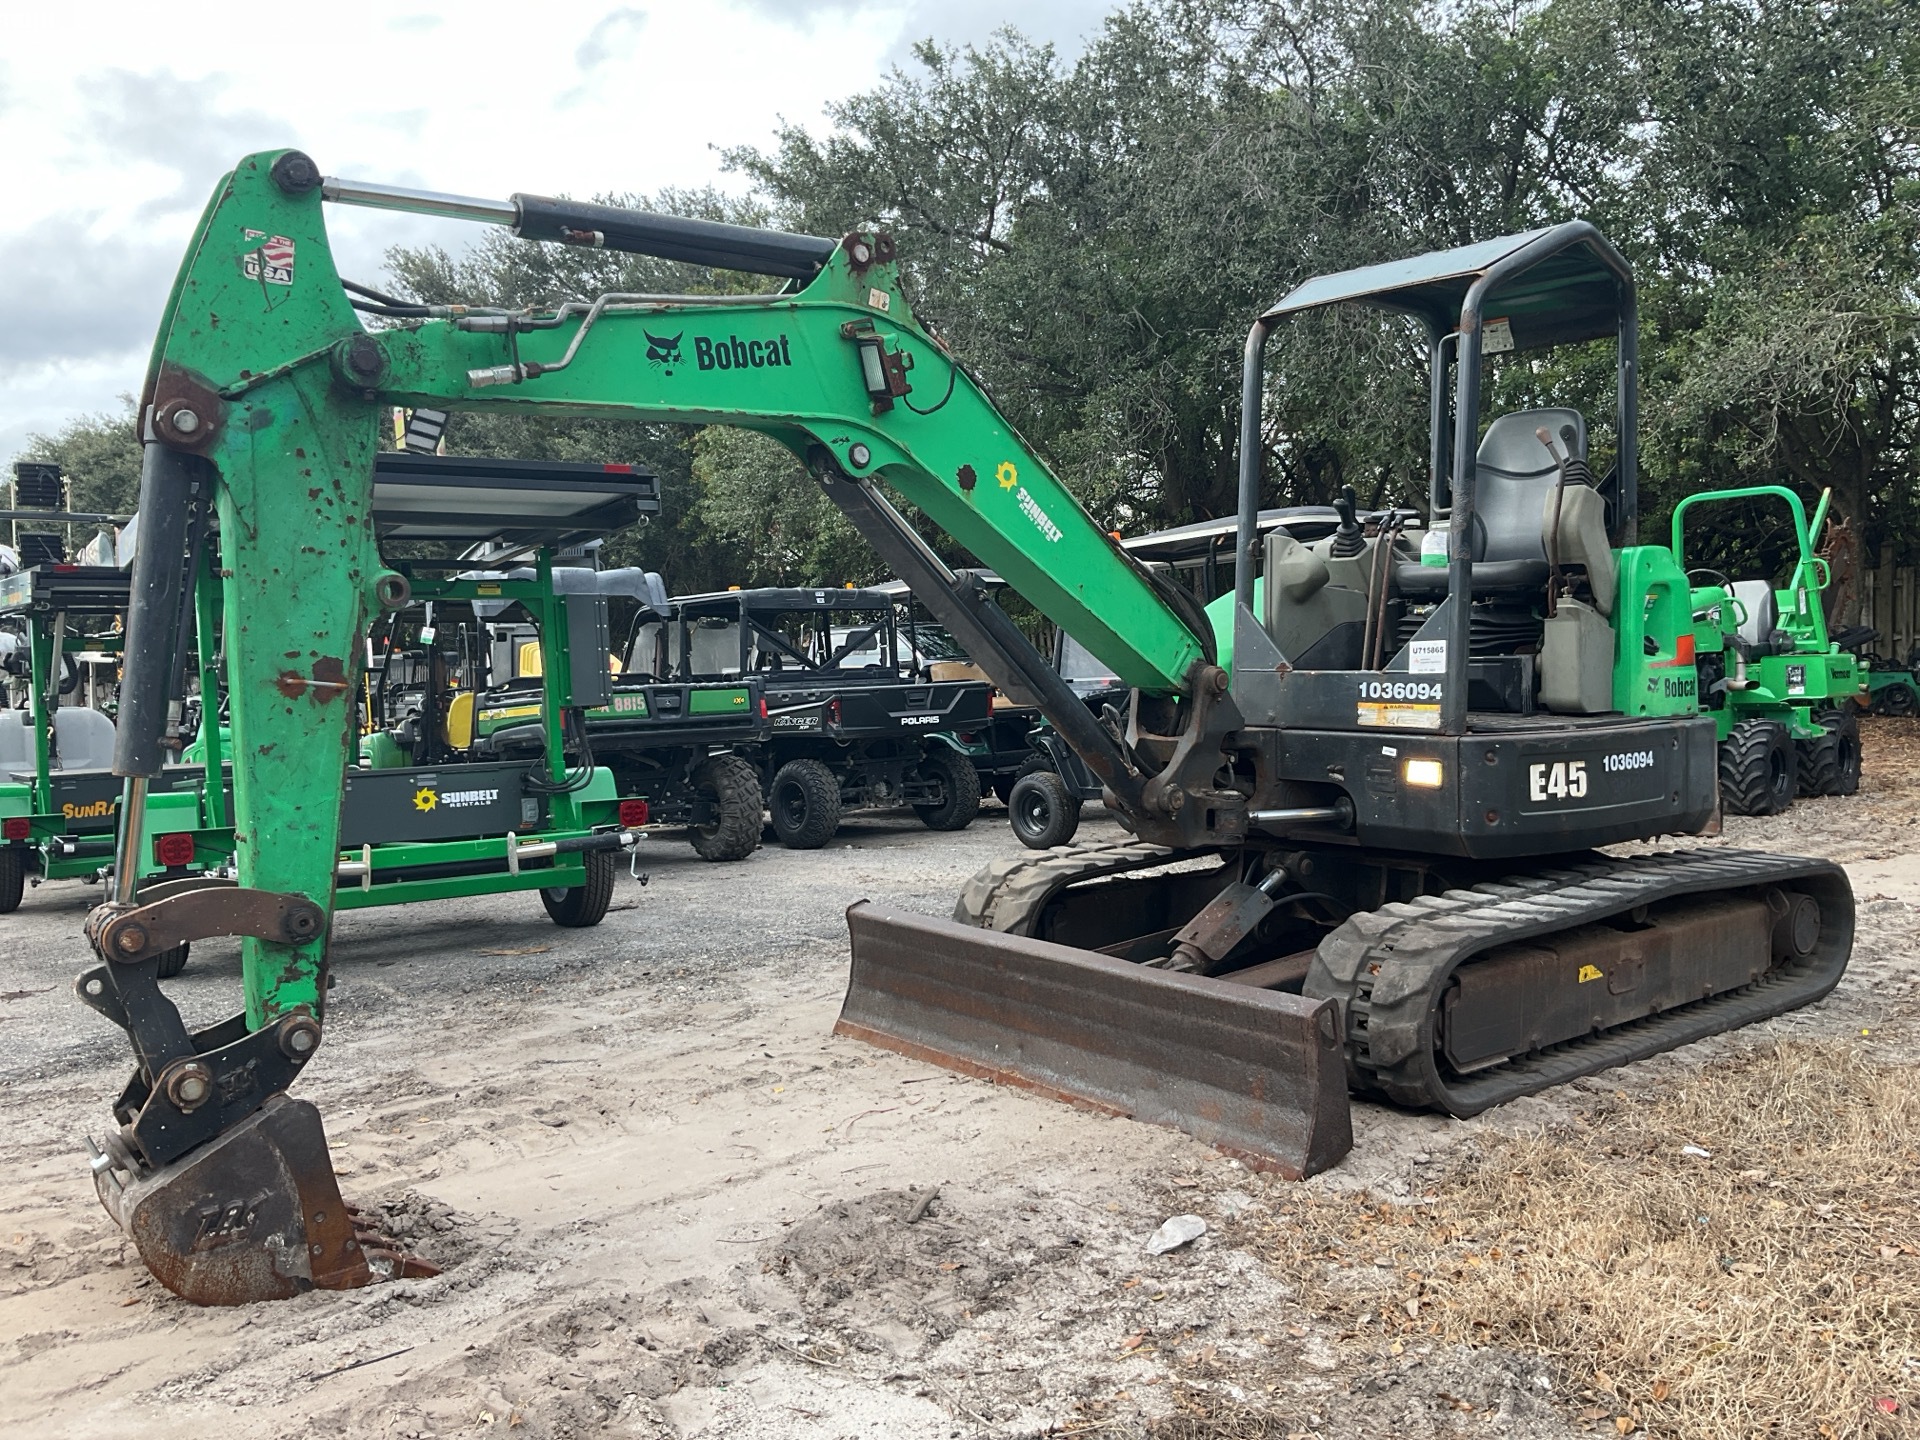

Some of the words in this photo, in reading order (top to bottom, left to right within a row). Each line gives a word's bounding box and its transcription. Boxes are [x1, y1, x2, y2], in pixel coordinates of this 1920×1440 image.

[247, 262, 290, 281] USA
[694, 334, 791, 371] Bobcat
[1016, 487, 1063, 543] SUNBELT
[1019, 503, 1051, 542] RENTALS
[1412, 646, 1444, 654] U715865
[1359, 682, 1443, 700] 1036094
[1664, 676, 1696, 698] Bobcat
[901, 715, 940, 726] POLARIS
[1603, 750, 1654, 772] 1036094
[1529, 760, 1588, 801] E45
[441, 789, 499, 804] SUNBELT
[450, 800, 492, 808] RENTALS
